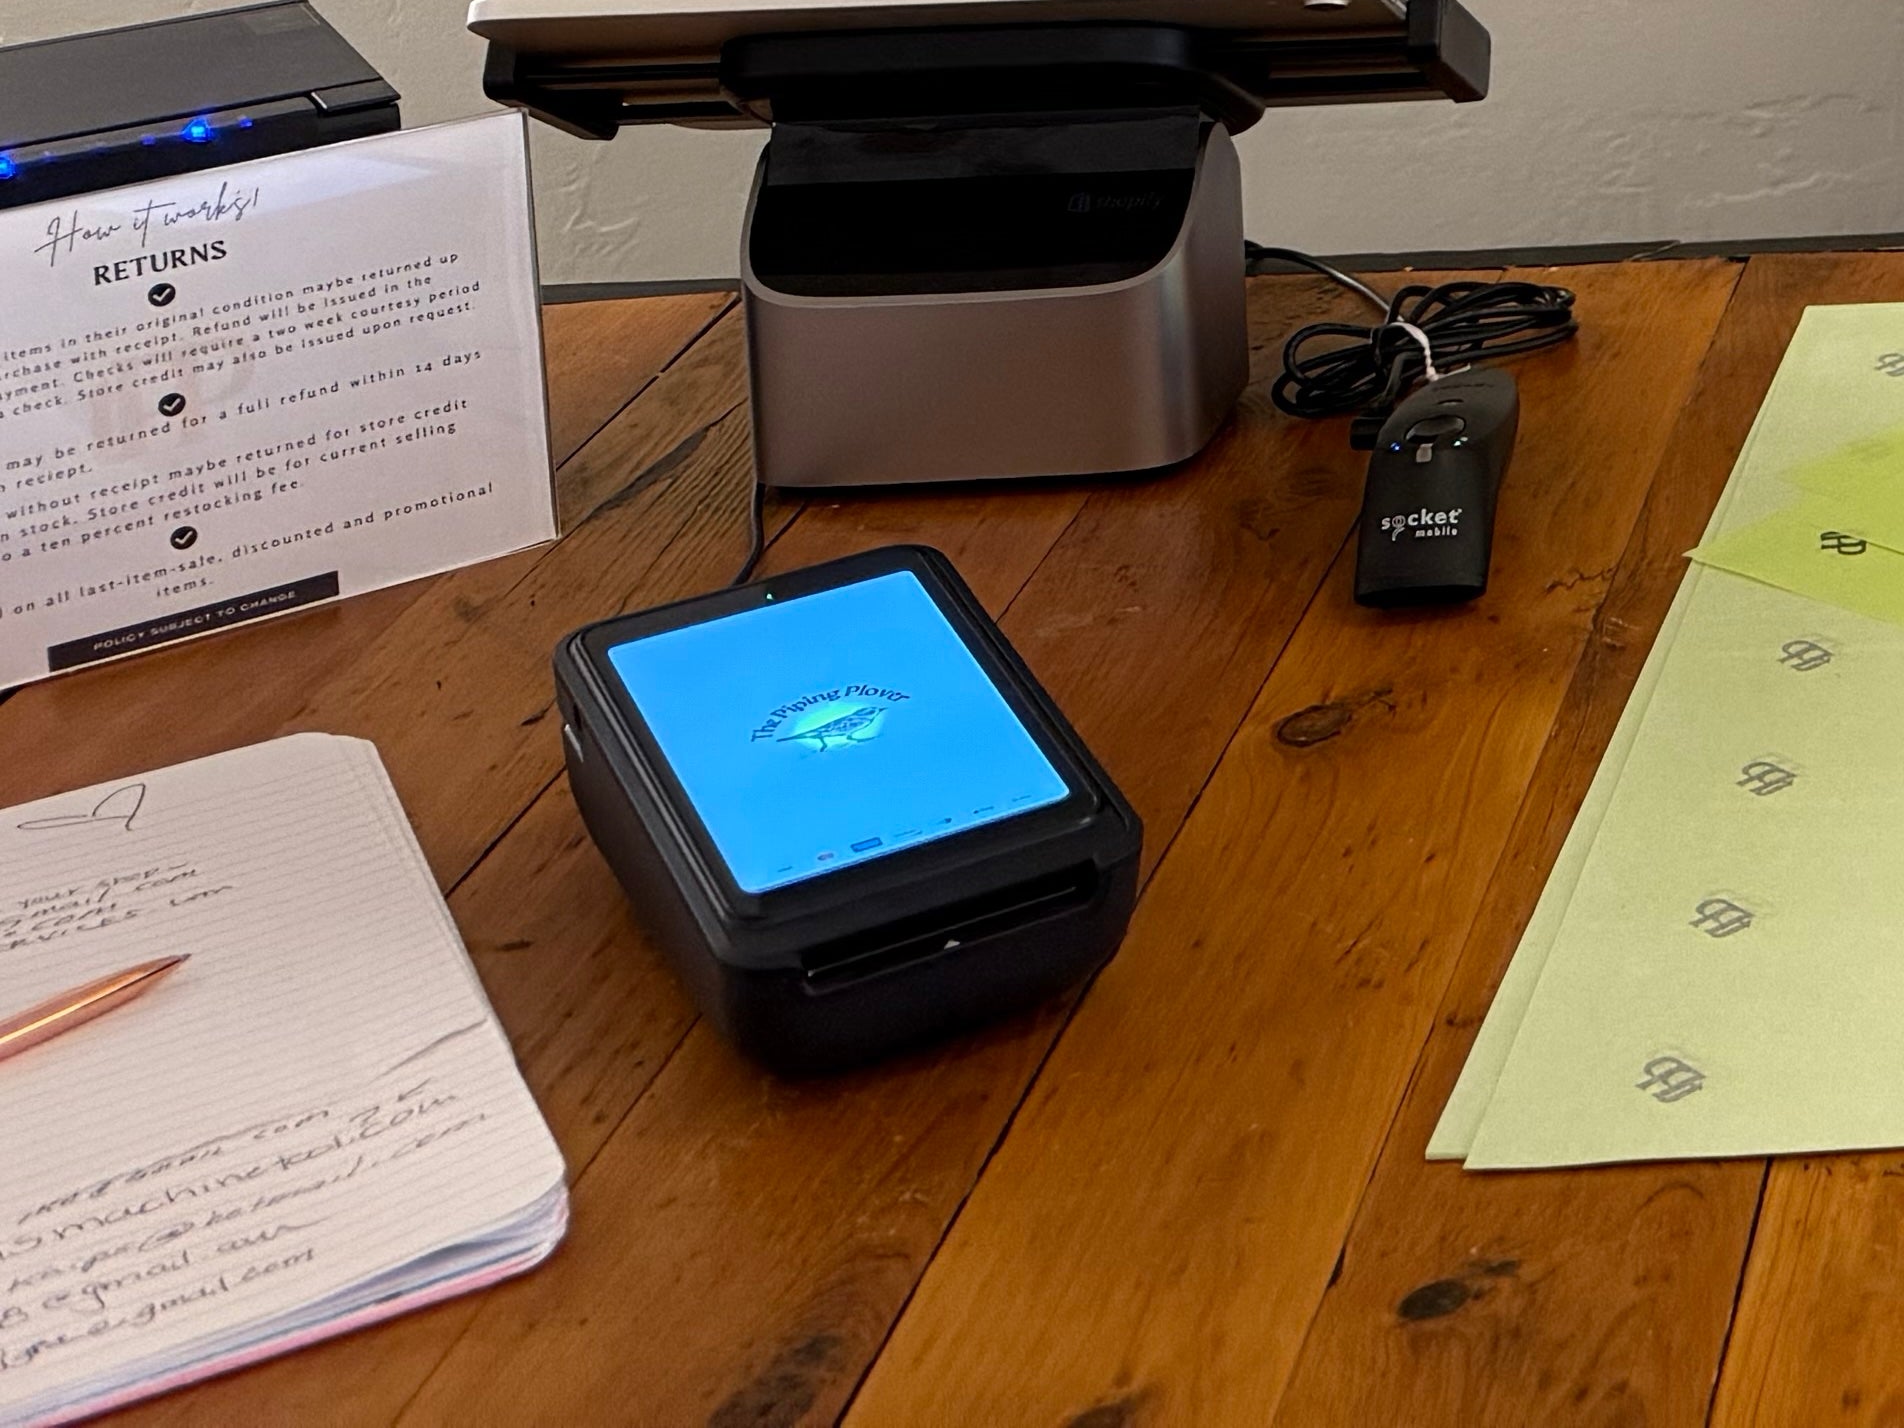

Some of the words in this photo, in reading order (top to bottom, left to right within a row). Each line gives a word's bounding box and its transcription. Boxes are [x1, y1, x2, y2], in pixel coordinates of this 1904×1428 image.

[34, 209, 122, 268] How
[133, 198, 177, 248] it
[92, 238, 229, 286] RETURNS
[0, 359, 62, 382] rchase
[68, 347, 107, 365] with
[191, 313, 251, 337] Refund
[257, 304, 289, 322] will
[296, 301, 316, 314] be
[323, 285, 376, 308] issued
[383, 282, 399, 294] in
[406, 275, 432, 289] the
[3, 343, 52, 362] items
[60, 337, 77, 349] in
[84, 325, 127, 344] their
[135, 306, 204, 332] original
[211, 289, 294, 315] condition
[301, 276, 354, 295] maybe
[360, 254, 432, 282] returned
[438, 252, 458, 264] up
[72, 360, 134, 383] Checks
[141, 349, 173, 366] will
[180, 336, 244, 358] require
[251, 333, 260, 343] a
[267, 324, 297, 339] two
[303, 310, 343, 331] week
[350, 296, 420, 320] courtesy
[428, 279, 481, 304] period
[76, 382, 123, 402] Store
[131, 367, 184, 388] credit
[191, 358, 224, 374] may
[231, 349, 267, 365] also
[274, 343, 293, 355] be
[300, 325, 355, 349] issued
[361, 317, 401, 335] upon
[5, 453, 43, 471] may
[54, 446, 76, 460] be
[86, 420, 171, 451] returned
[180, 414, 207, 429] for
[217, 409, 227, 421] a
[236, 396, 270, 415] full
[279, 379, 339, 405] refund
[348, 367, 405, 389] within
[415, 361, 433, 373] 14
[441, 349, 481, 367] days
[4, 492, 80, 520] without
[89, 473, 159, 500] receipt
[167, 458, 227, 481] maybe
[235, 432, 316, 464] returned
[324, 427, 350, 442] for
[358, 414, 405, 433] store
[413, 398, 468, 420] credit
[18, 513, 78, 538] stock.
[86, 500, 139, 521] Store
[147, 481, 205, 506] credit
[212, 469, 246, 490] will
[255, 465, 276, 479] be
[284, 456, 310, 472] for
[319, 436, 386, 463] current
[394, 421, 456, 445] selling
[12, 600, 35, 615] on
[43, 589, 70, 607] all
[231, 520, 334, 559] discounted
[342, 510, 374, 530] and
[382, 480, 493, 522] promotional
[20, 547, 32, 558] a
[39, 536, 71, 553] ten
[79, 513, 154, 545] percent
[163, 488, 263, 522] restocking
[1381, 507, 1462, 535] socket
[92, 630, 144, 651] POLICY
[148, 612, 210, 637] SUBJECT
[216, 605, 235, 619] TO
[238, 590, 296, 613] CHANGE
[750, 718, 783, 743] The
[769, 688, 841, 719] Piping
